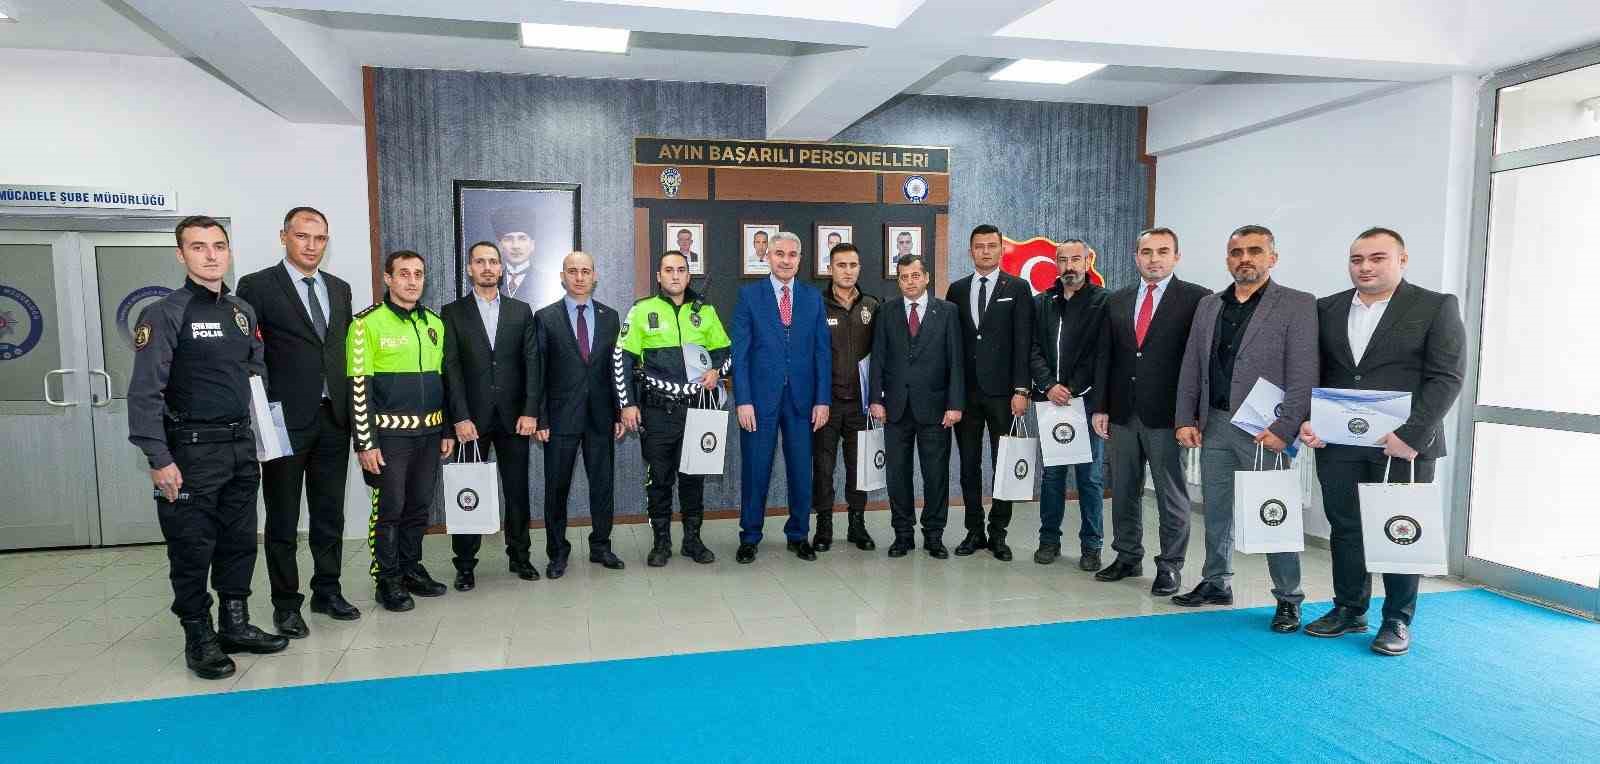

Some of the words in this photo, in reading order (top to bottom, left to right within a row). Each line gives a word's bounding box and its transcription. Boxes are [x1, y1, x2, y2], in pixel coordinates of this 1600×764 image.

[658, 143, 703, 160] AYIN
[709, 145, 794, 164] BAŞARILI
[799, 149, 928, 168] PERSONELLERİ
[0, 188, 56, 202] MÜCADELE
[60, 191, 89, 205] ŞUBE
[93, 191, 165, 206] MÜDÜRLÜĞÜ
